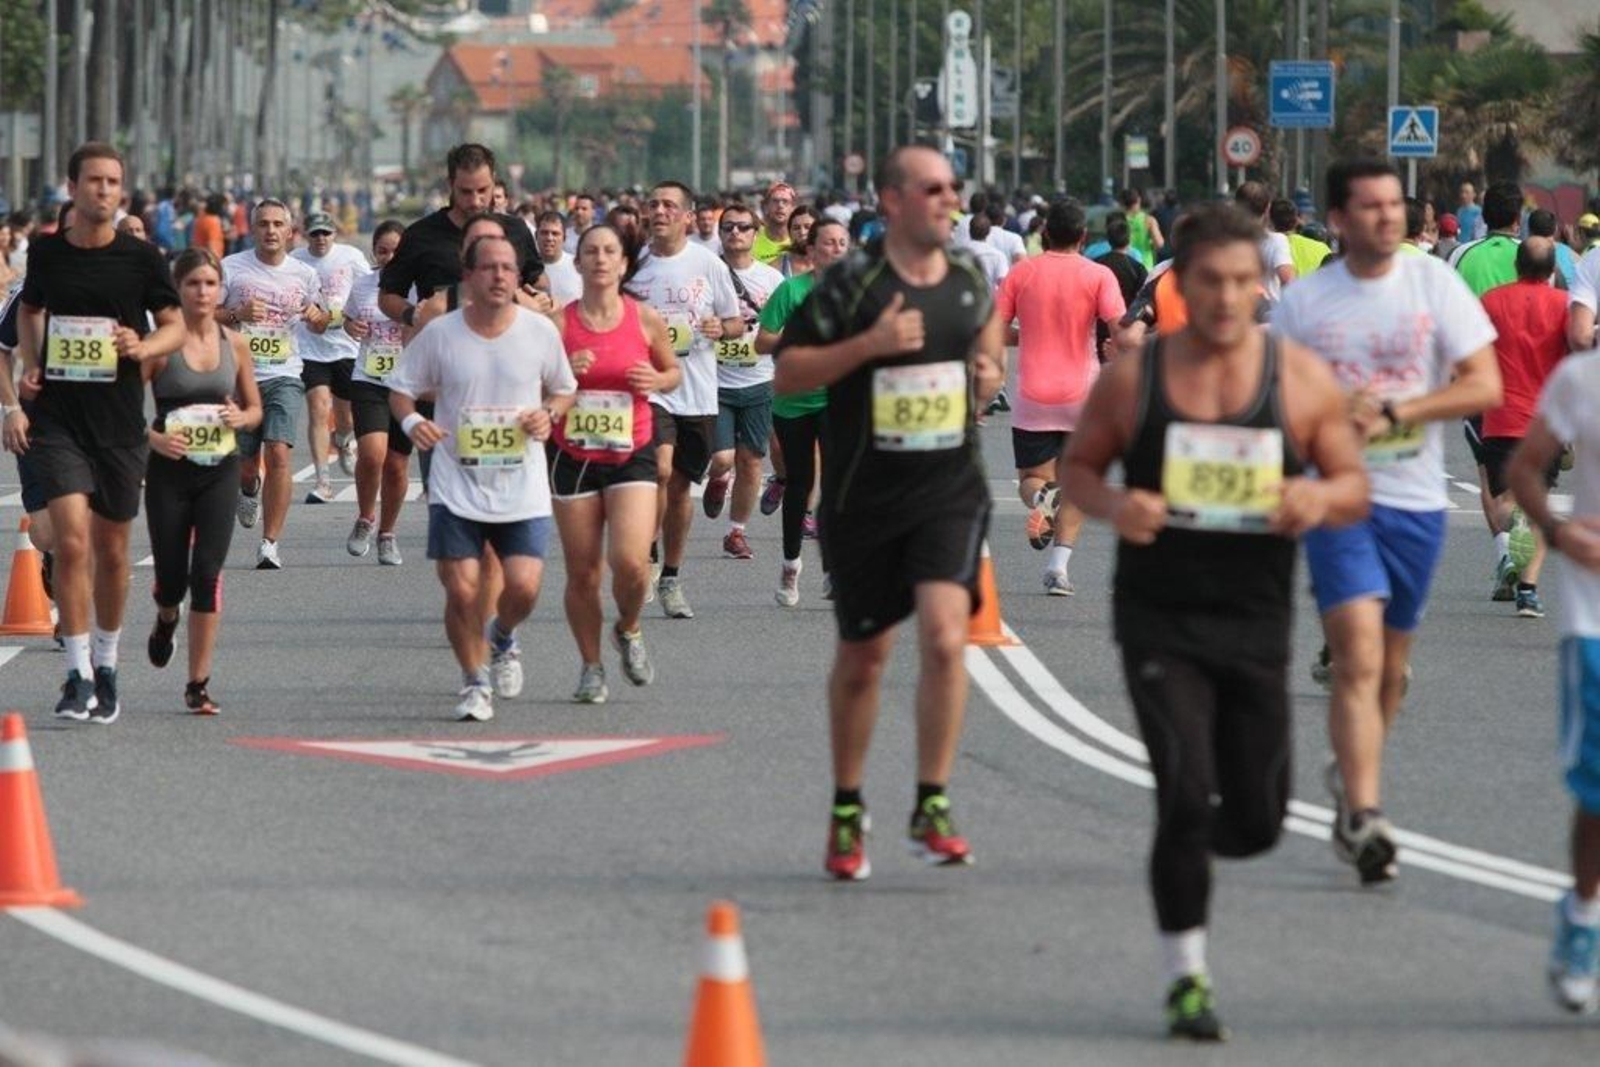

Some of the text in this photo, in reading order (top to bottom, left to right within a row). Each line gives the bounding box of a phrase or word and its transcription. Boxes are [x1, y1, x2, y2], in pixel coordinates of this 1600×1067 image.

[1230, 141, 1252, 153] 40
[59, 339, 102, 360] 338
[249, 337, 280, 354] 605
[719, 341, 750, 357] 334
[894, 395, 950, 426] 829
[573, 414, 624, 434] 1034
[470, 428, 515, 449] 545
[1190, 462, 1256, 503] 891
